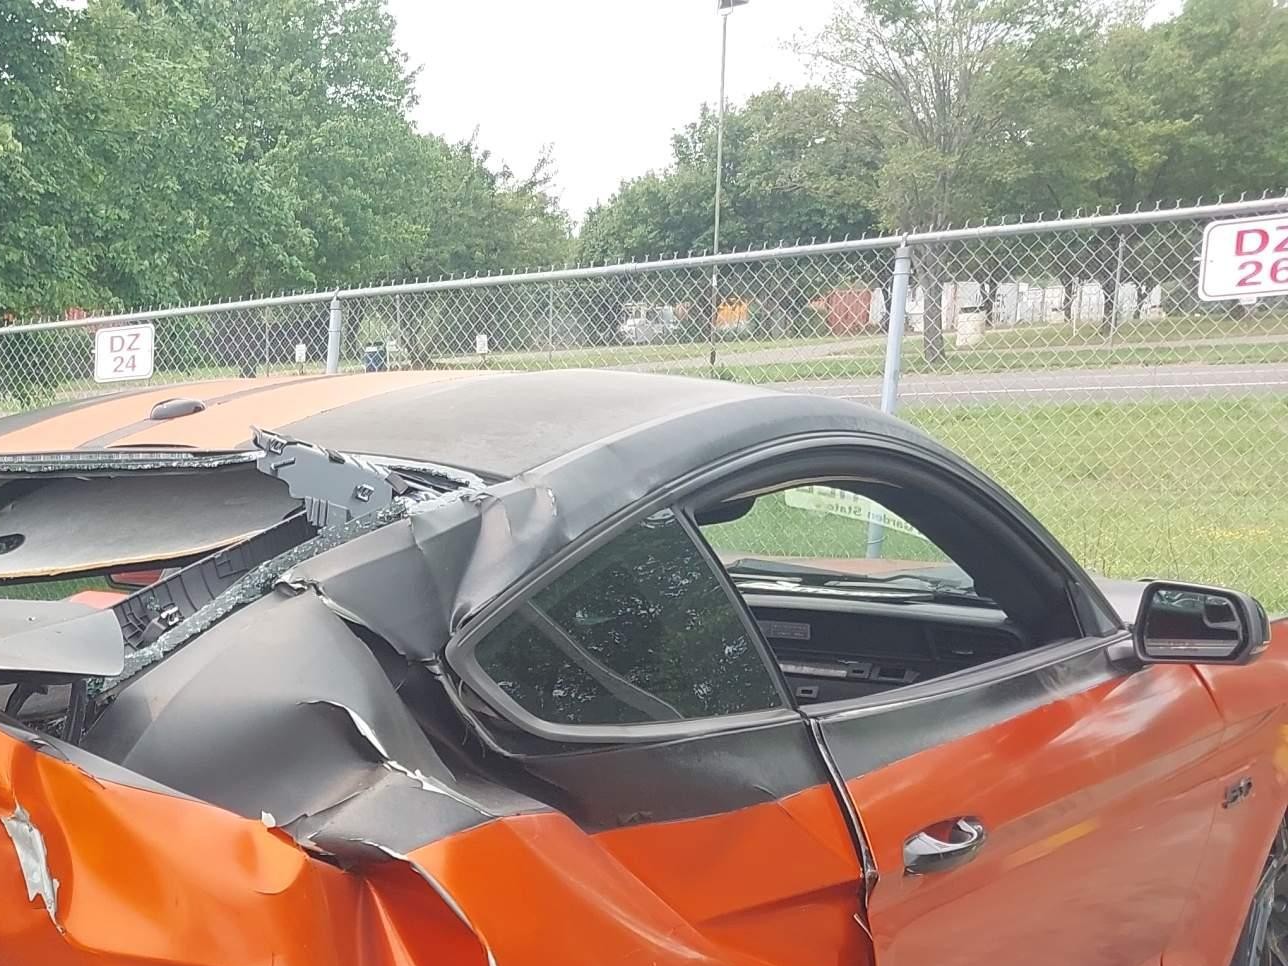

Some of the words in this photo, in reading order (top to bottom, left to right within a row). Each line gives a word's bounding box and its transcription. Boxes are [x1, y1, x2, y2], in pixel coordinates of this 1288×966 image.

[1235, 258, 1288, 287] 26
[110, 333, 141, 353] DZ
[113, 355, 136, 373] 24
